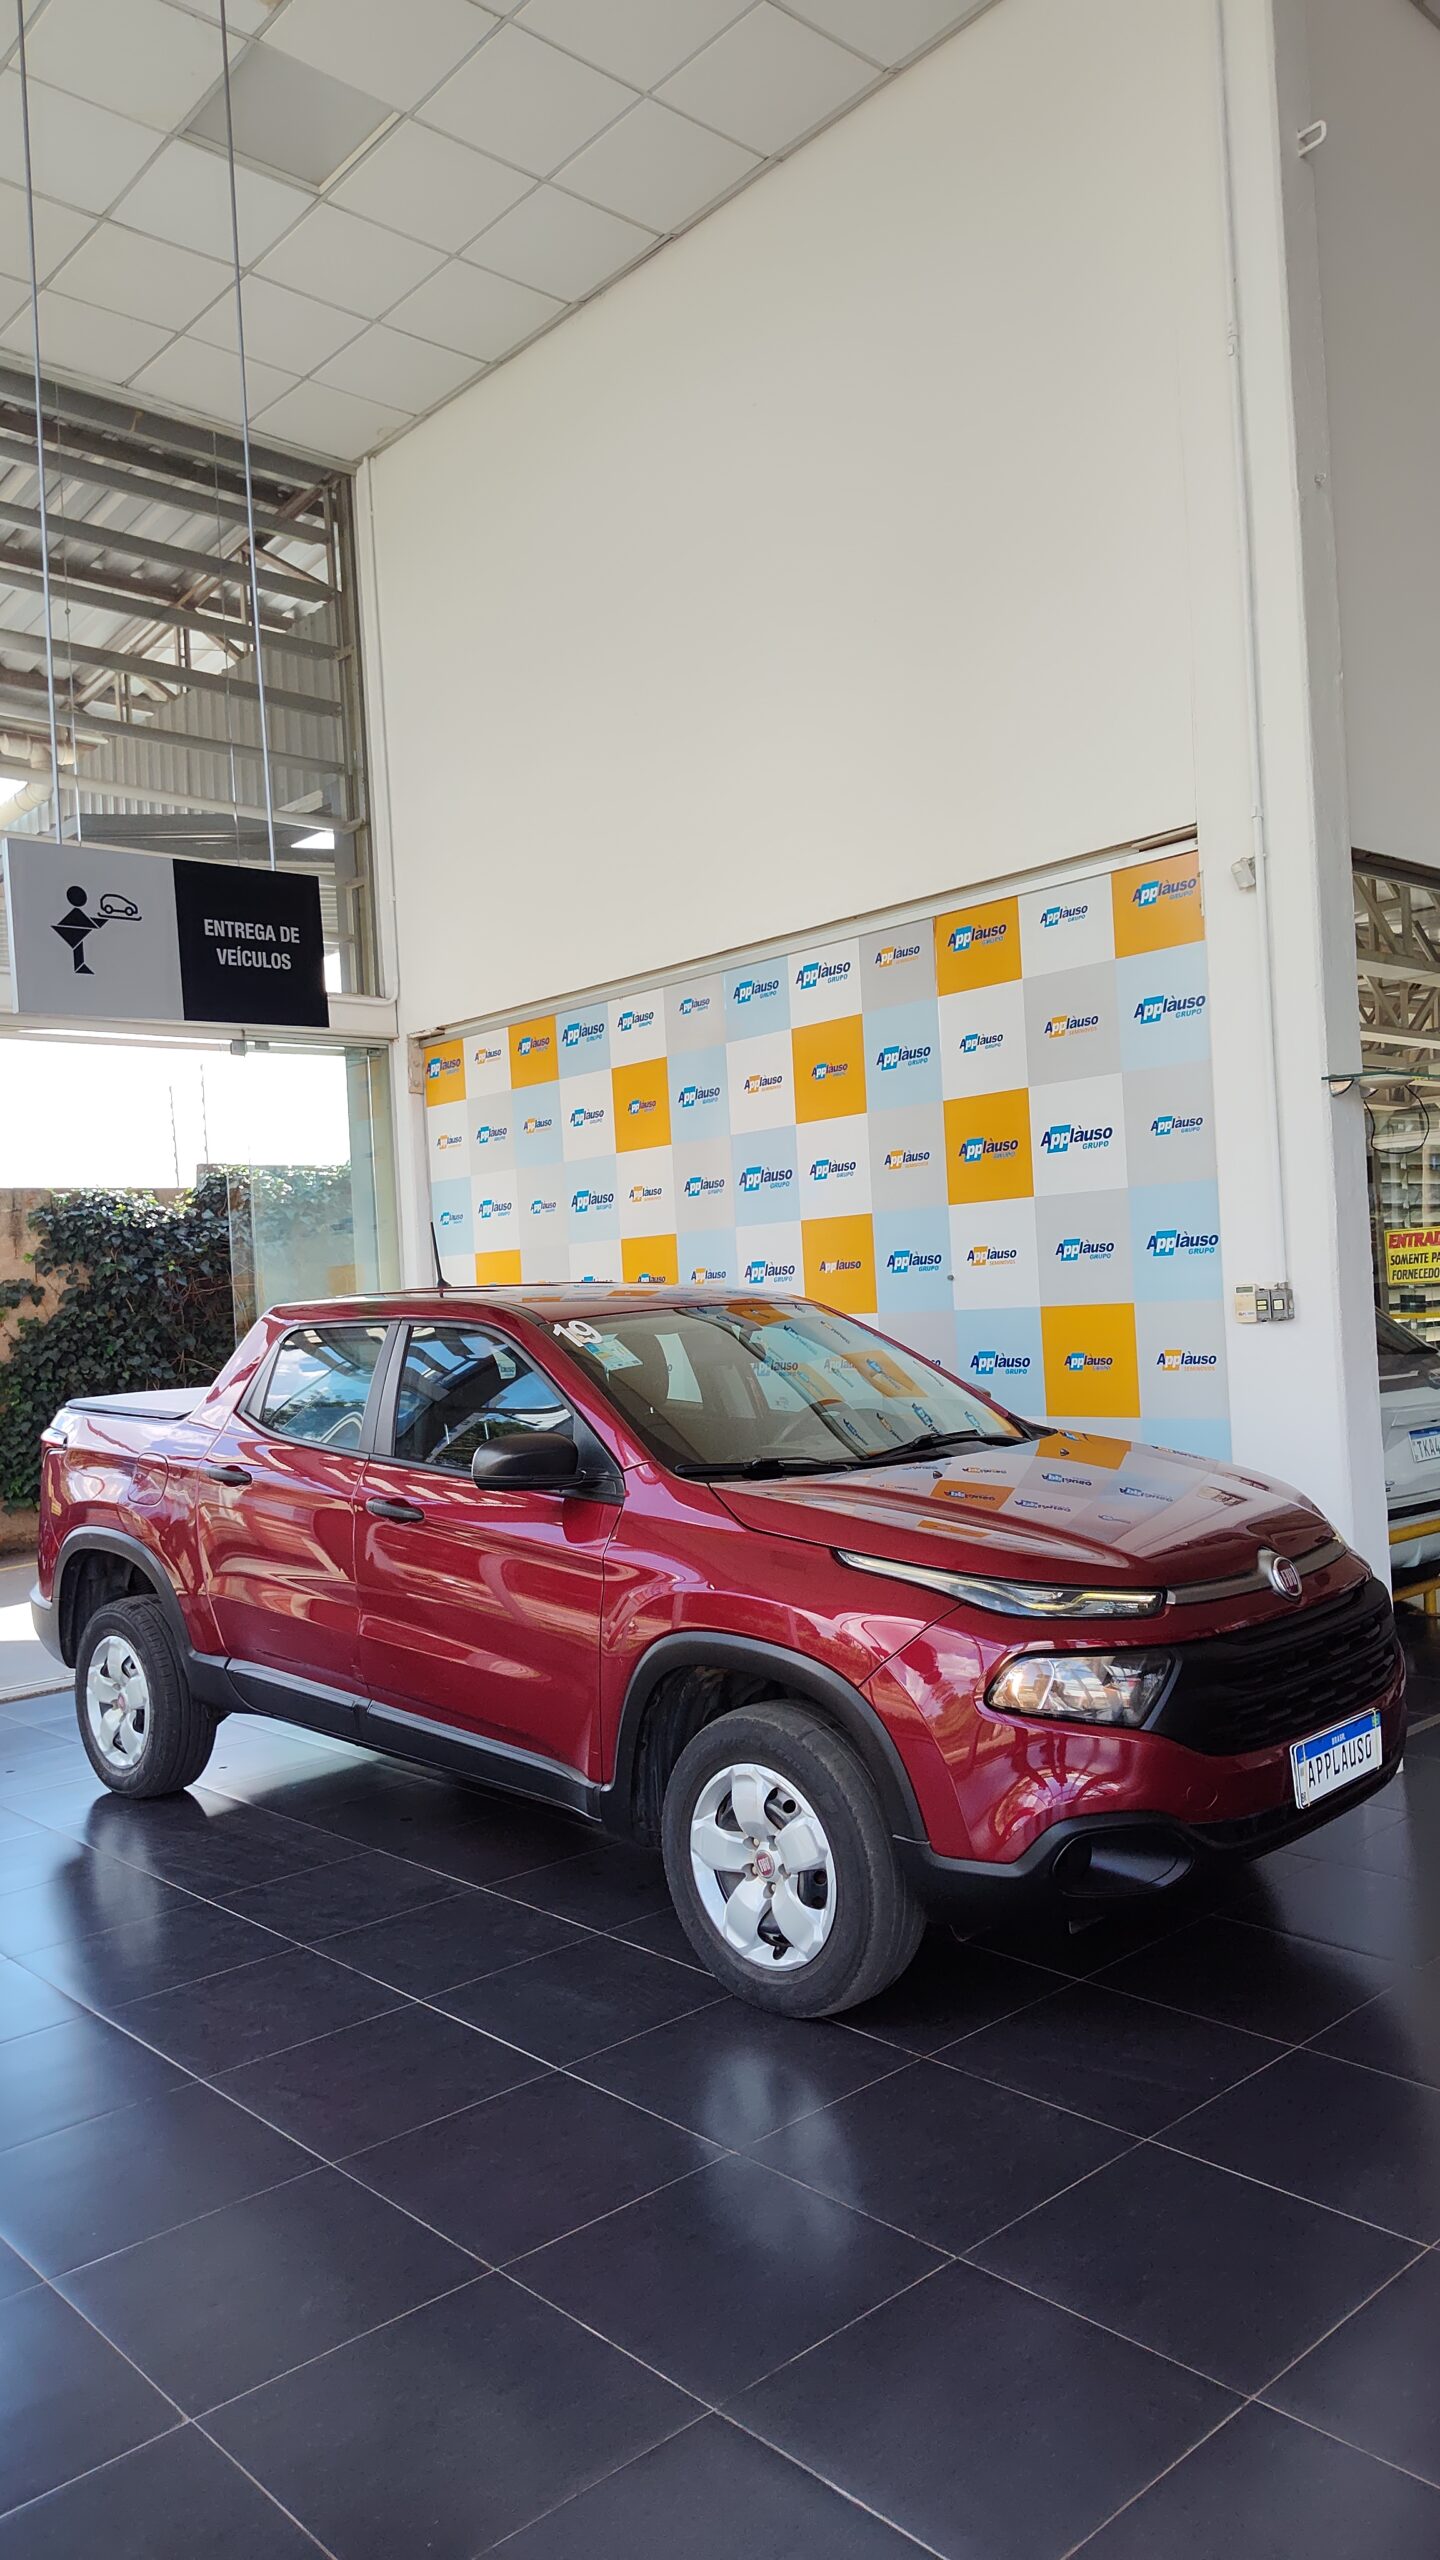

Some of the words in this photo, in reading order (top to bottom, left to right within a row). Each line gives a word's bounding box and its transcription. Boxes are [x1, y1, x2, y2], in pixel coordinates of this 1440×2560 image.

[1169, 889, 1194, 900] GRUPO
[1067, 914, 1086, 923] GRUPO
[204, 919, 276, 942] ENTREGA
[280, 926, 300, 944] DE
[216, 945, 292, 971] VEÍCULOS
[827, 974, 848, 984] GRUPO
[1175, 1008, 1202, 1019] GRUPO
[908, 1057, 928, 1066] GRUPO
[1180, 1126, 1200, 1134] GRUPO
[1082, 1140, 1109, 1150] GRUPO
[770, 1181, 790, 1189] GRUPO
[1188, 1247, 1215, 1255] GRUPO
[1089, 1252, 1112, 1261] GRUPO
[1390, 1252, 1429, 1266] SOMENTE
[918, 1264, 940, 1272] GRUPO
[552, 1320, 603, 1348] 19
[1005, 1367, 1028, 1375] GRUPO
[1308, 1733, 1372, 1788] APPLAUSO
